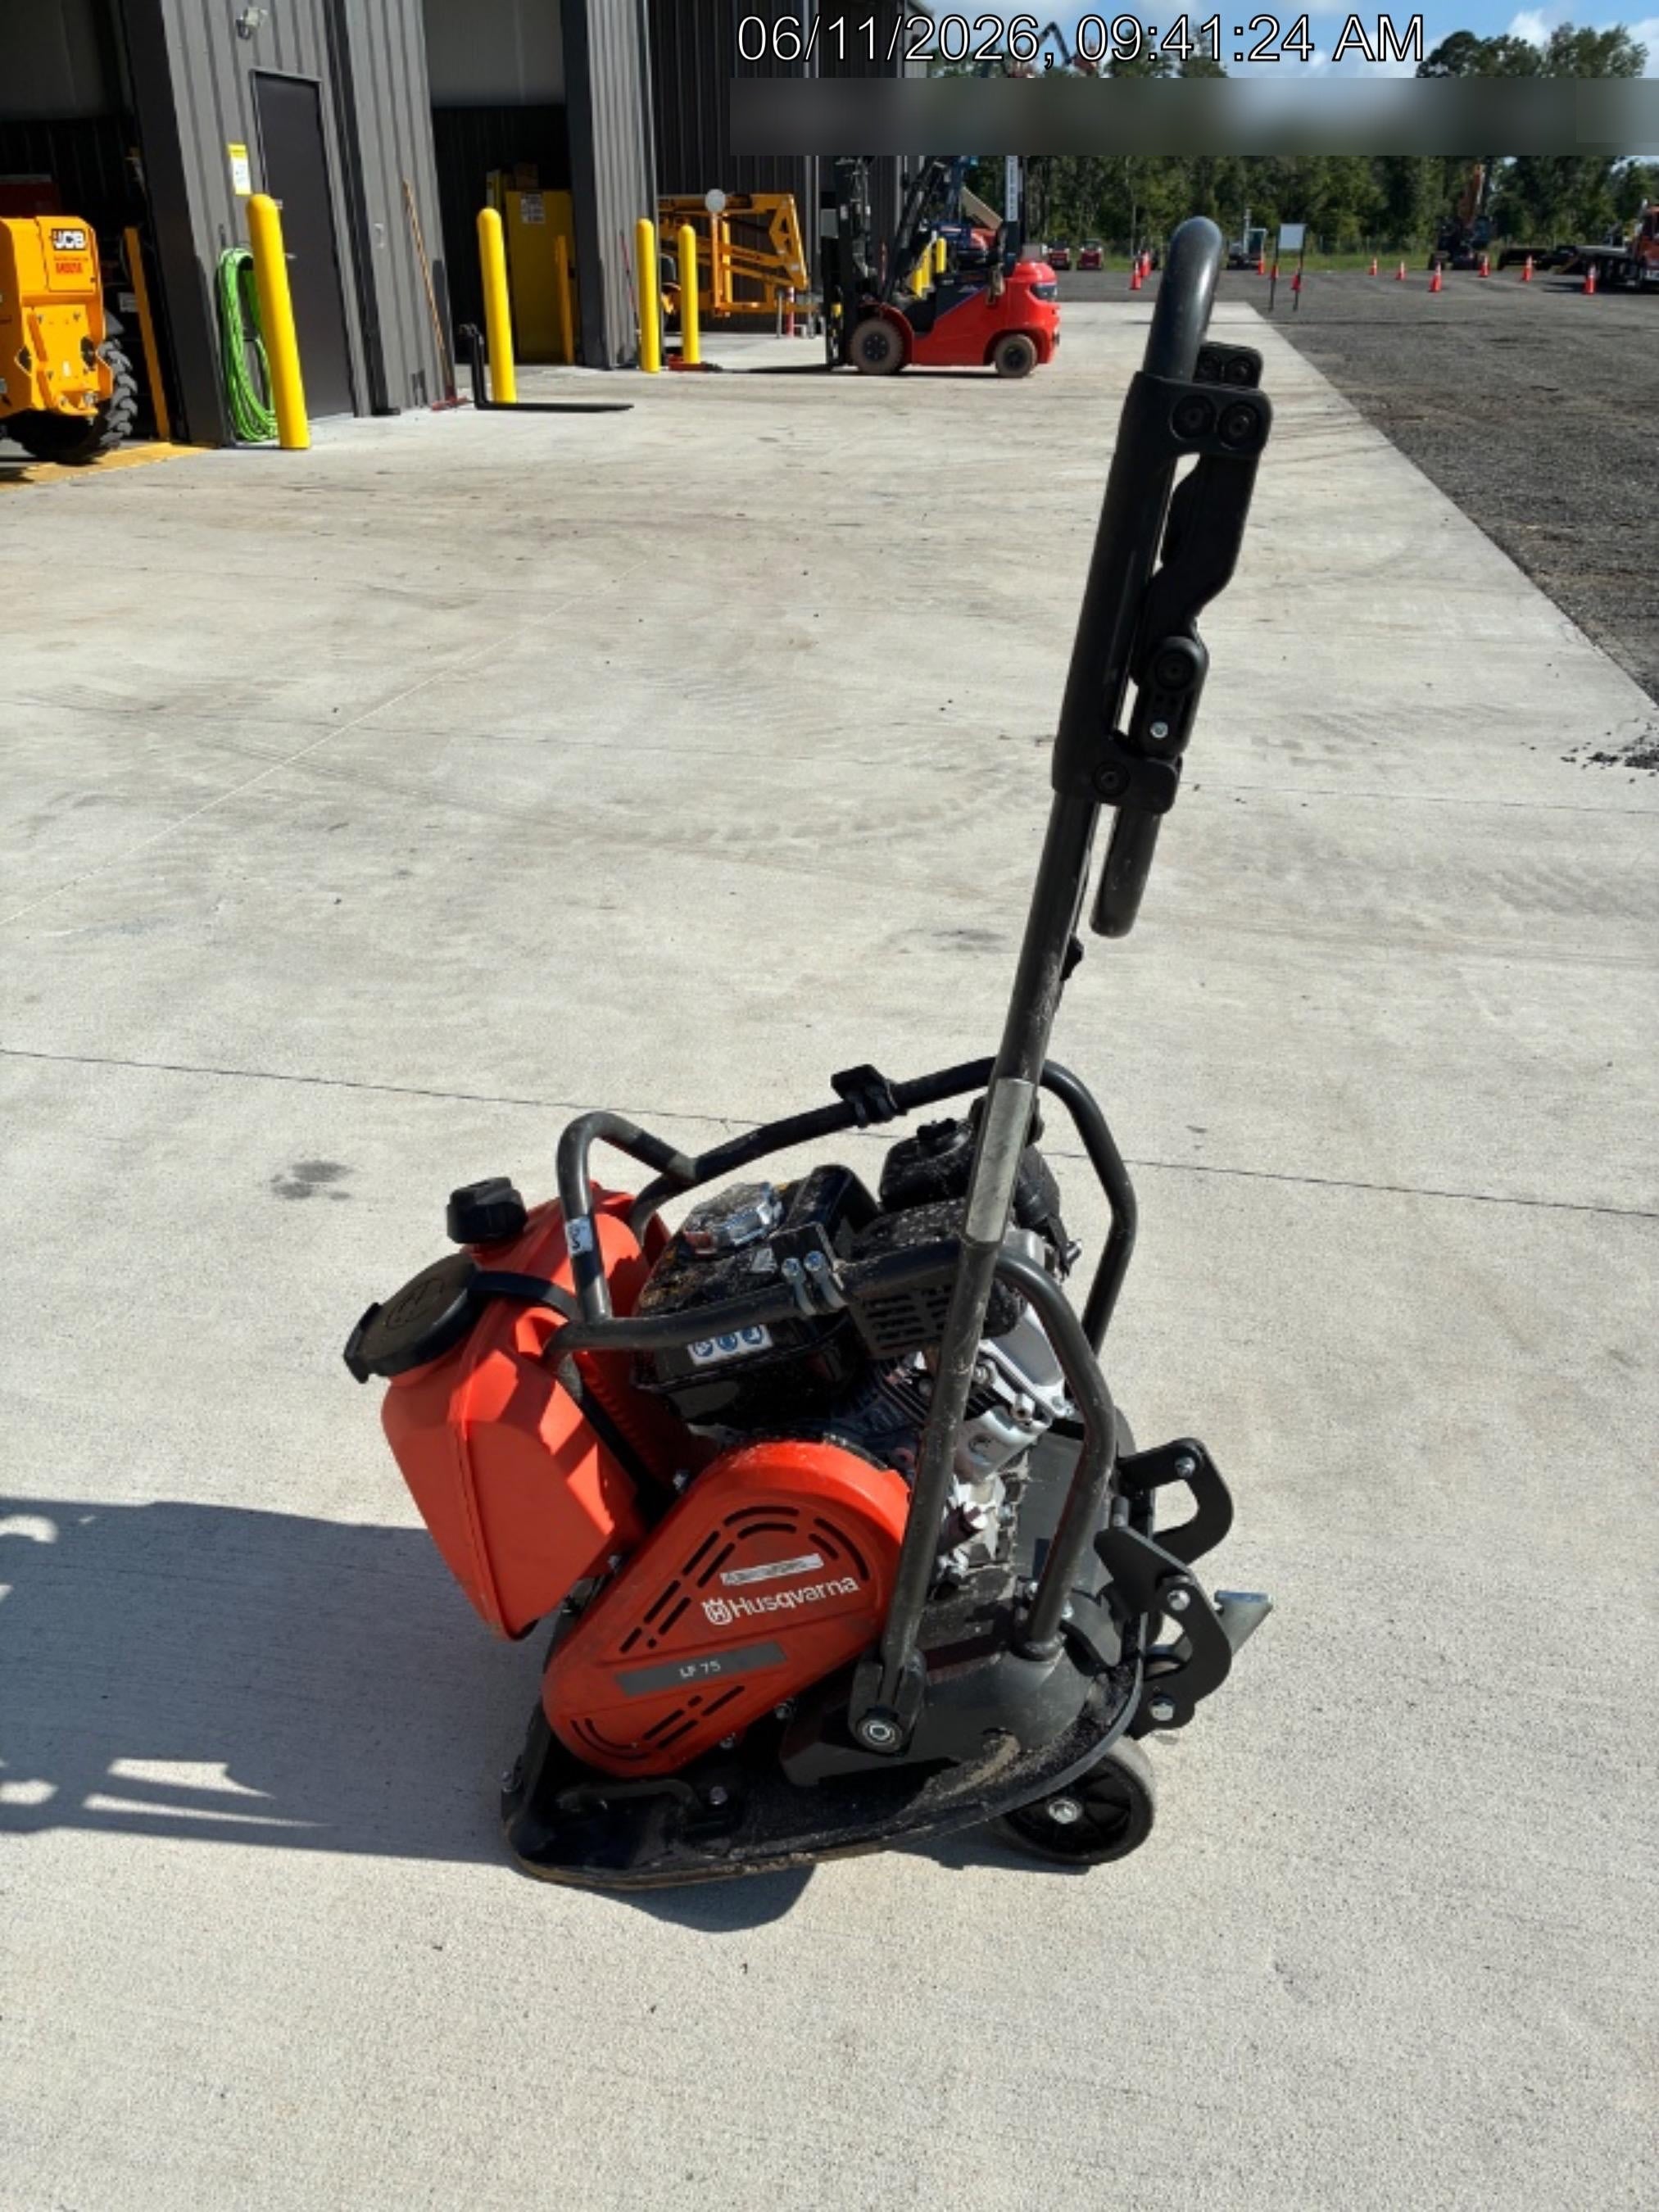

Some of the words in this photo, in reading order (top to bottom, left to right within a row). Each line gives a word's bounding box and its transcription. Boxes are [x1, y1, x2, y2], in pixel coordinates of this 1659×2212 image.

[55, 230, 84, 249] JCB
[728, 1576, 860, 1619] Husqvarna
[700, 1659, 722, 1675] 75
